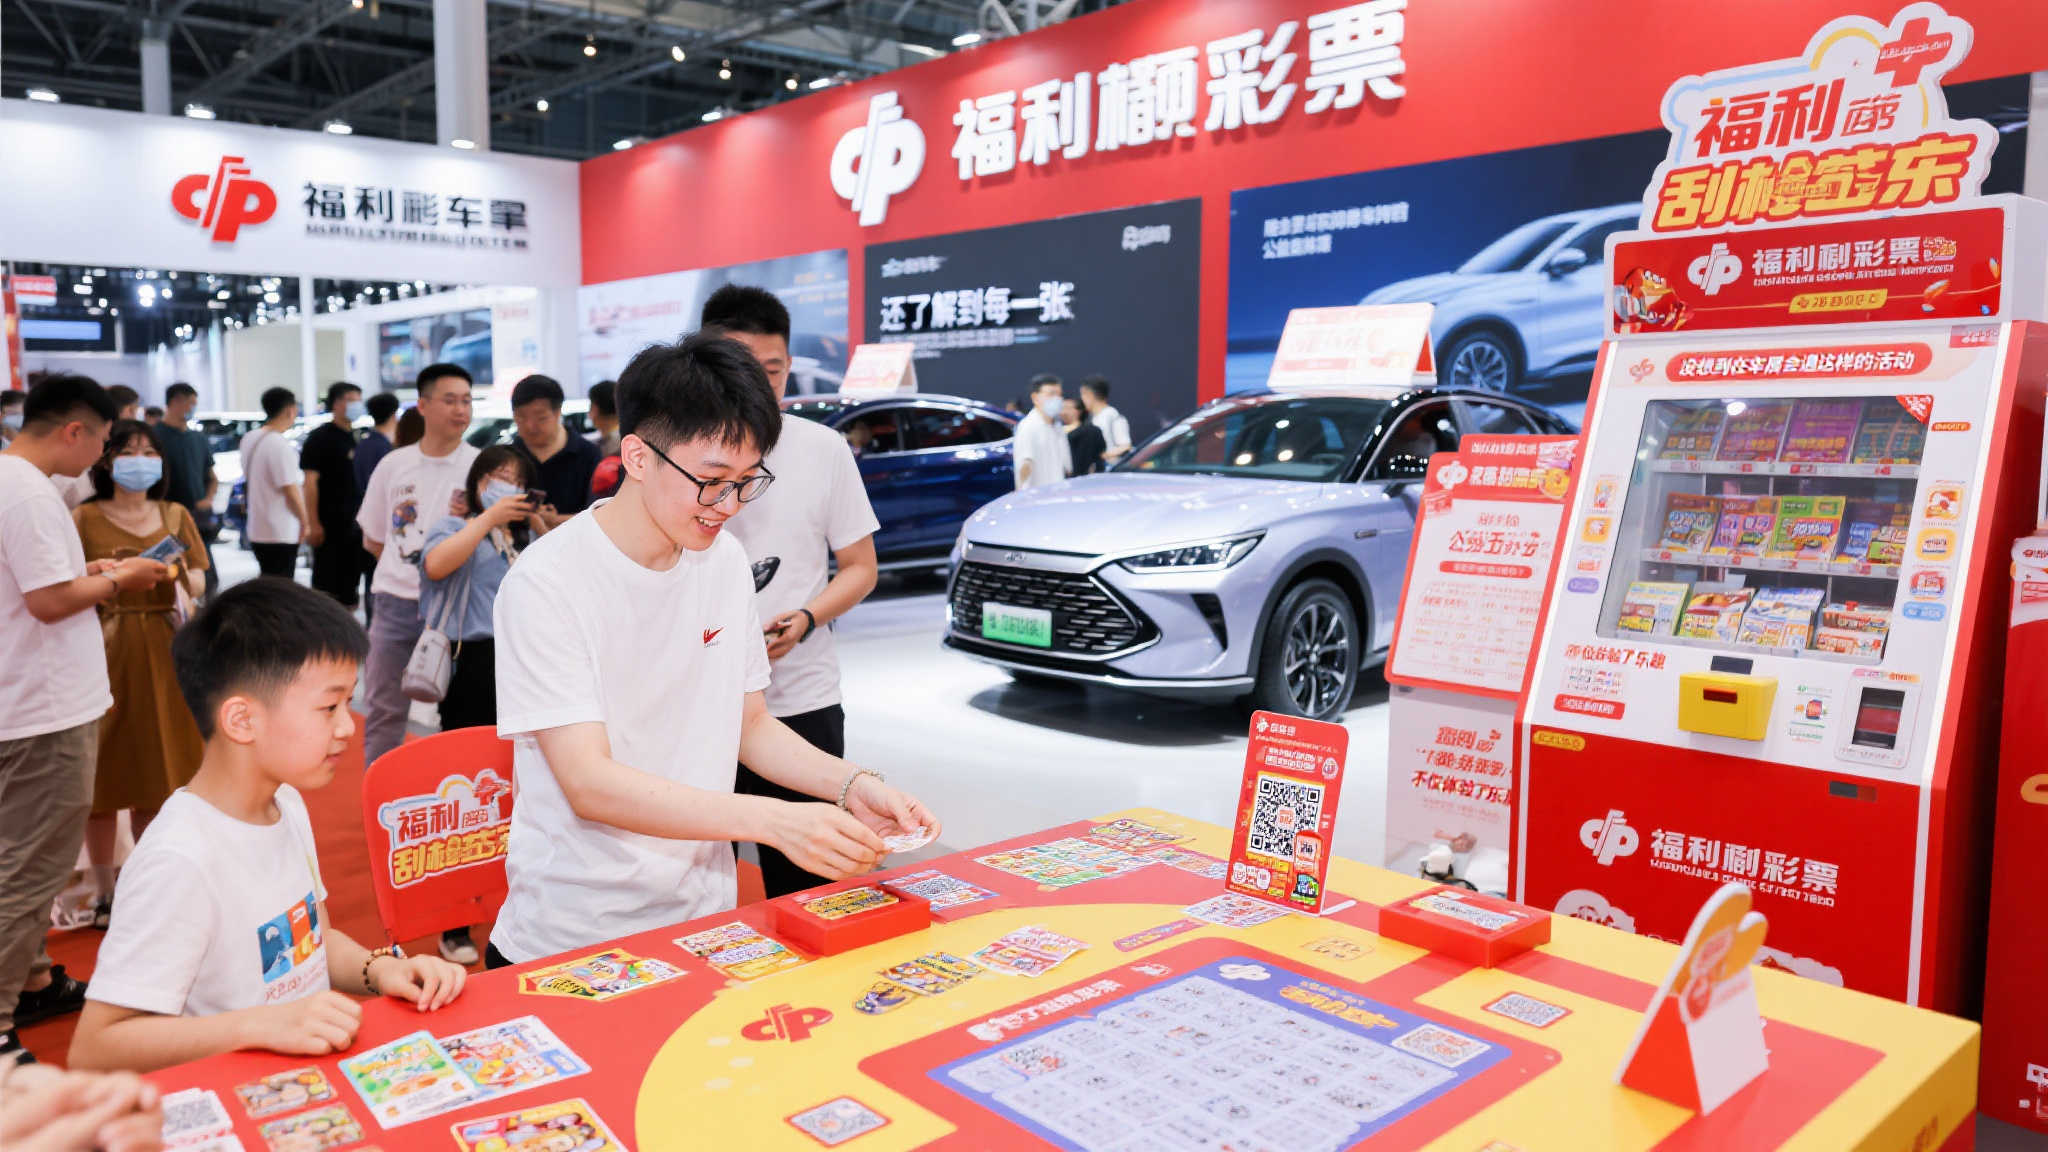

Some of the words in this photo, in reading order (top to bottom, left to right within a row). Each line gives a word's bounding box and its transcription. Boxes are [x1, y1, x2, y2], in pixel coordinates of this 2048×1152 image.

[951, 1, 1406, 180] 福利彩票
[1752, 236, 1920, 276] 福利彩票
[1650, 829, 1840, 894] 福利彩票
